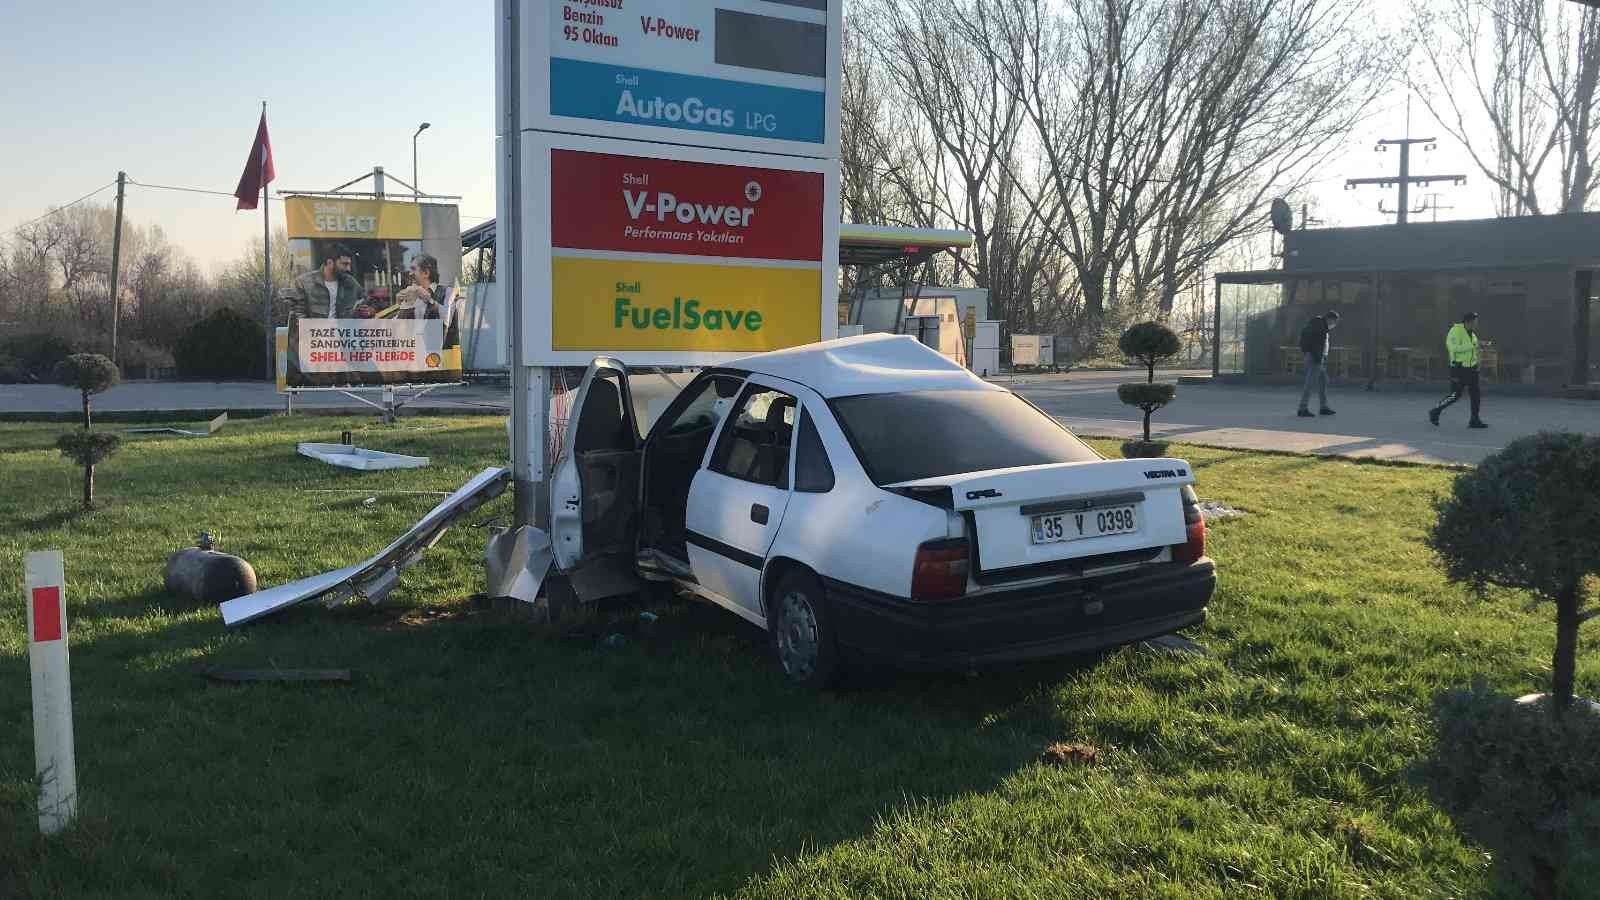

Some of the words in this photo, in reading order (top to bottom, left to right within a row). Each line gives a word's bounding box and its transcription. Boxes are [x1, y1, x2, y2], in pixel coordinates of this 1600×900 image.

[563, 5, 604, 26] Benzin
[564, 25, 579, 42] 95
[582, 28, 619, 48] Oktan
[640, 15, 701, 43] V-Power
[615, 73, 639, 88] Shell
[615, 89, 735, 128] AutoGas
[745, 111, 777, 132] LPG
[622, 173, 649, 186] Shell
[623, 189, 755, 228] V-Power
[314, 215, 376, 233] SELECT
[624, 225, 693, 242] Performans
[696, 232, 744, 244] Yakıtları
[615, 282, 641, 294] Shell
[613, 296, 763, 332] FuelSave
[339, 328, 351, 337] VE
[310, 352, 346, 362] SHELL
[350, 352, 373, 361] HEP
[966, 489, 1002, 500] OPEL
[1044, 517, 1063, 538] 35
[1075, 514, 1084, 535] Y
[1097, 509, 1134, 533] 0398
